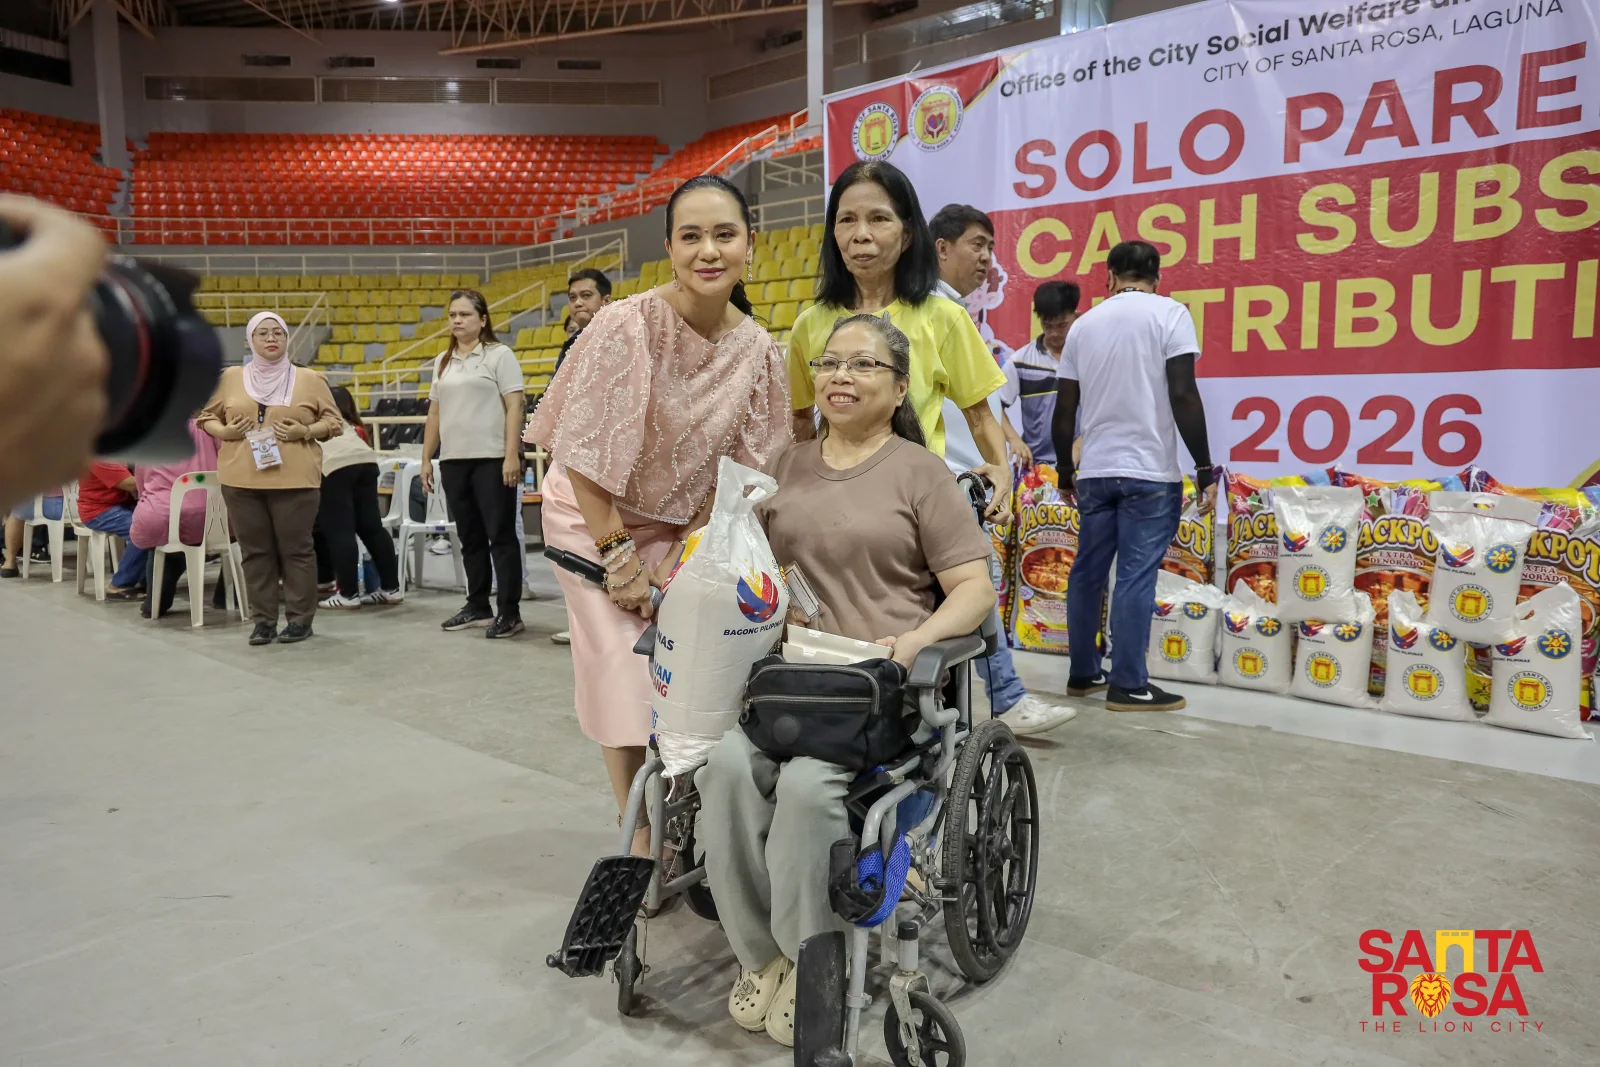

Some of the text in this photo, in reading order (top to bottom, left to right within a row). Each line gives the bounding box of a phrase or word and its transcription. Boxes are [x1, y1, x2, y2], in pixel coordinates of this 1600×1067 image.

[1000, 71, 1065, 97] Office
[1073, 60, 1098, 83] of
[1103, 55, 1141, 77] the
[1149, 42, 1199, 67] City
[1206, 19, 1289, 55] Social
[1299, 0, 1420, 36] Welfare
[1203, 1, 1564, 83] CITY OF SANTA ROSA, LAGUNA
[868, 105, 890, 114] SANTA
[890, 112, 898, 135] ROSA
[1012, 40, 1600, 200] SOLO PARE
[1016, 150, 1600, 279] CASH SUBS
[1229, 394, 1483, 467] 2026
[1379, 551, 1413, 559] EXTRA
[1466, 585, 1486, 594] SANTA
[723, 627, 758, 636] BAGONG
[1522, 672, 1544, 681] SANTA
